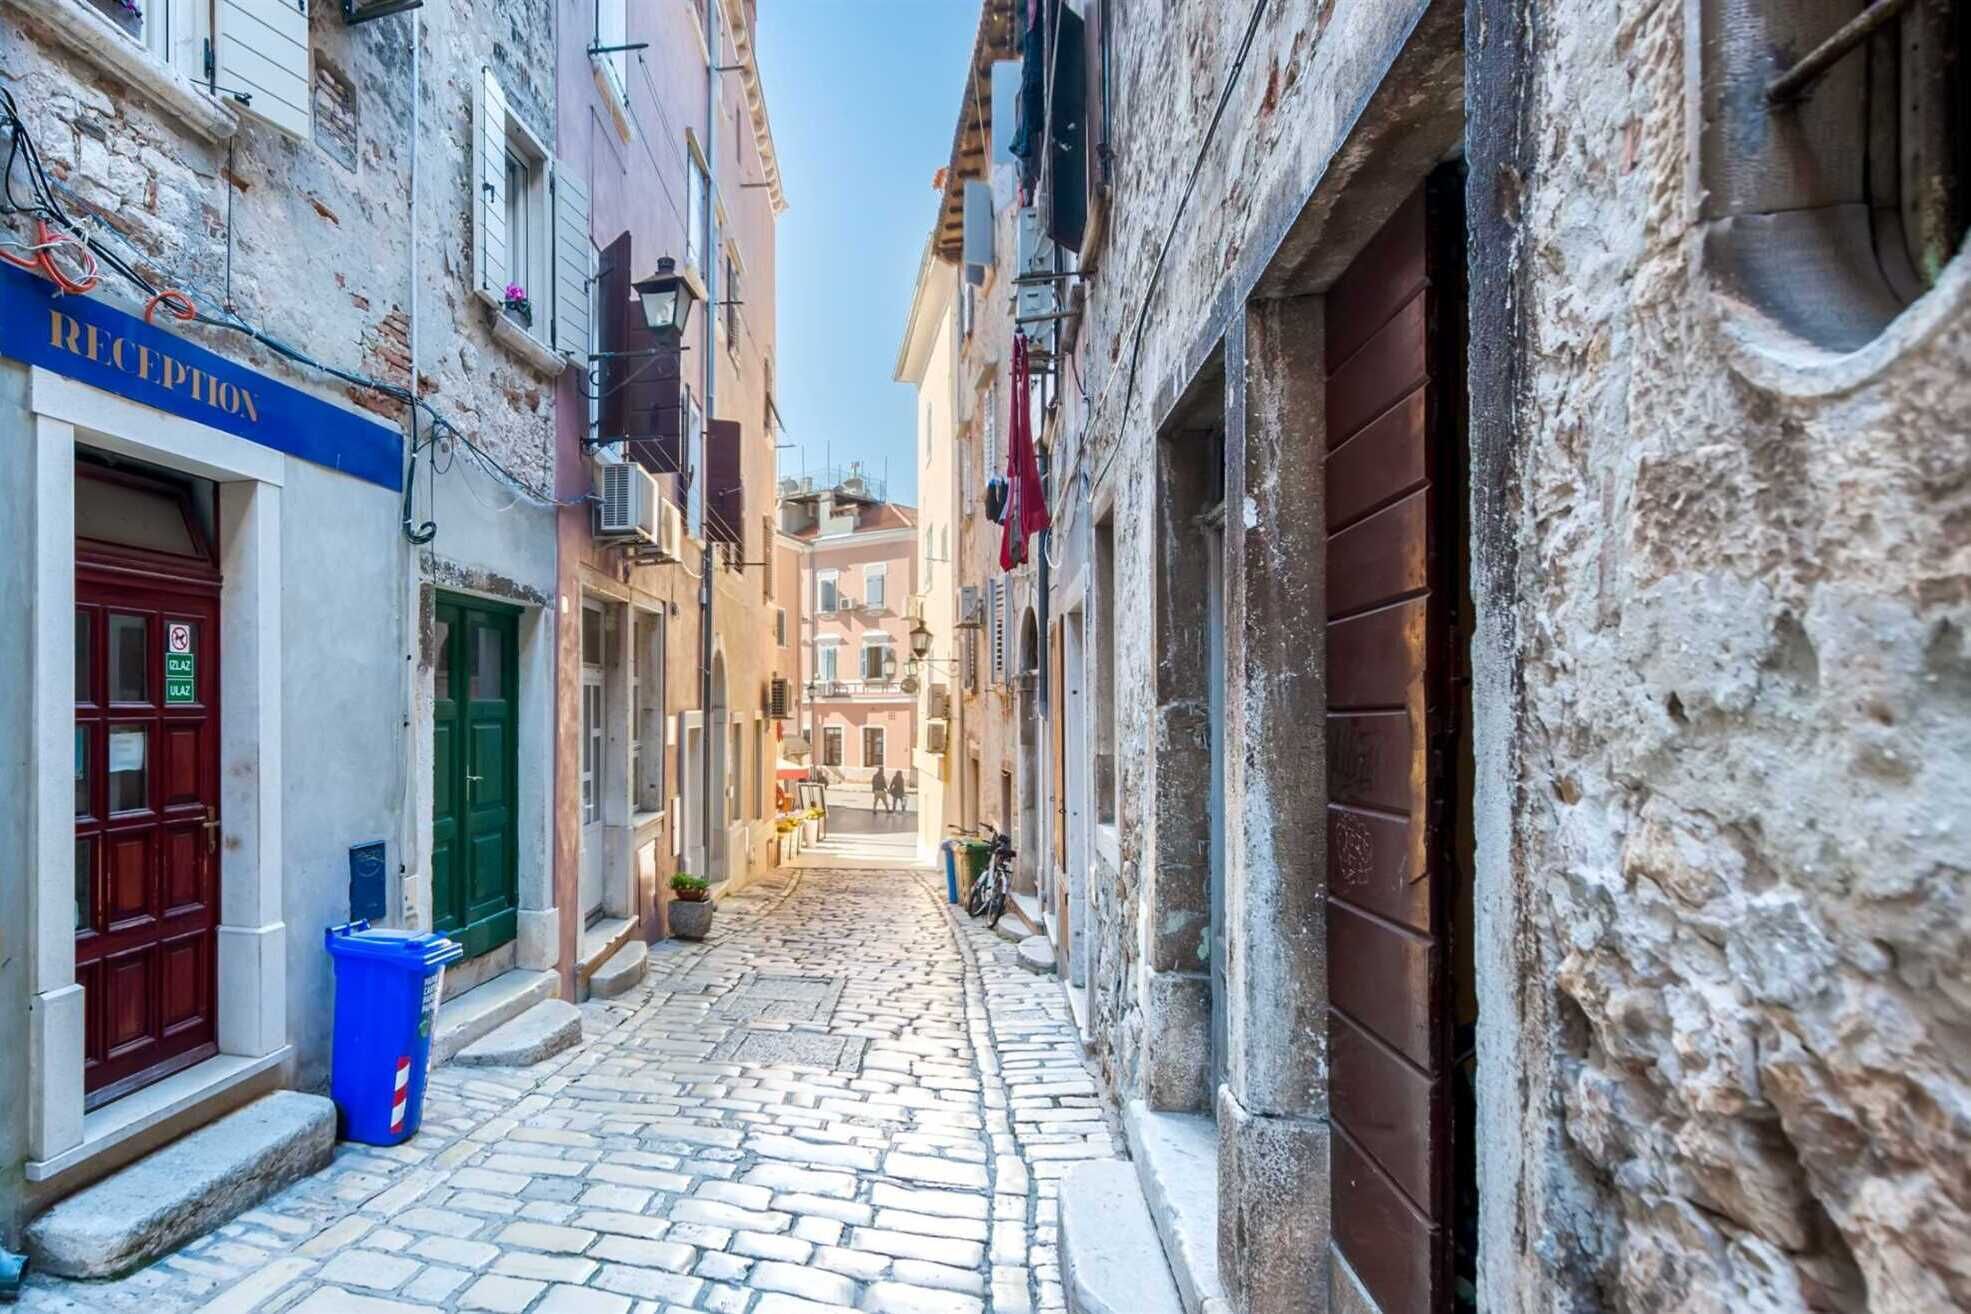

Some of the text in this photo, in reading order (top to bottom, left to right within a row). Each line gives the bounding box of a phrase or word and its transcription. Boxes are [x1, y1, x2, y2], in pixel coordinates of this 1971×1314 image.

[49, 309, 259, 422] RECEPTION
[169, 659, 191, 671] IZLAZ
[170, 685, 191, 696] ULAZ
